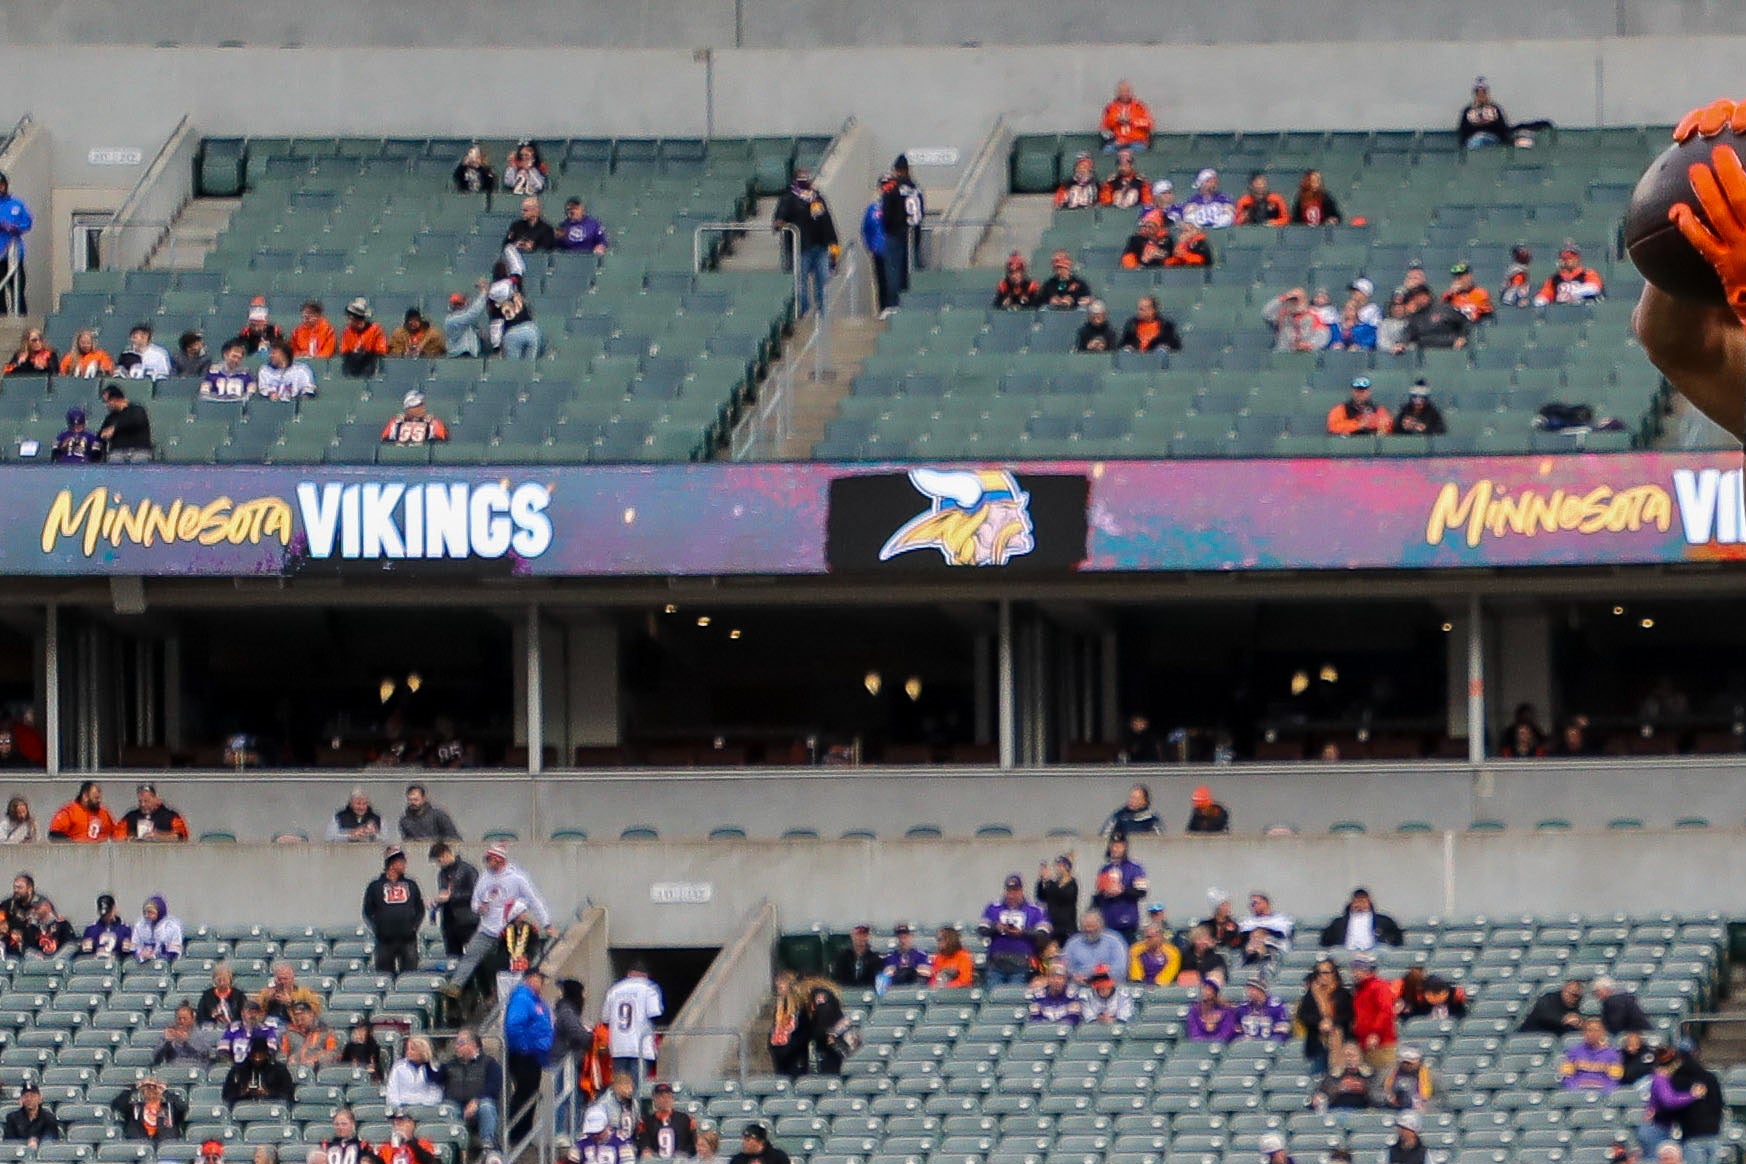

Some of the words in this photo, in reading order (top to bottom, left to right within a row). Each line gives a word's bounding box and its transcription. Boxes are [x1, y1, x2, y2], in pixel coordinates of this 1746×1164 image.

[296, 481, 555, 558] VIKINGS
[618, 1001, 634, 1029] 9
[658, 1129, 675, 1158] 9
